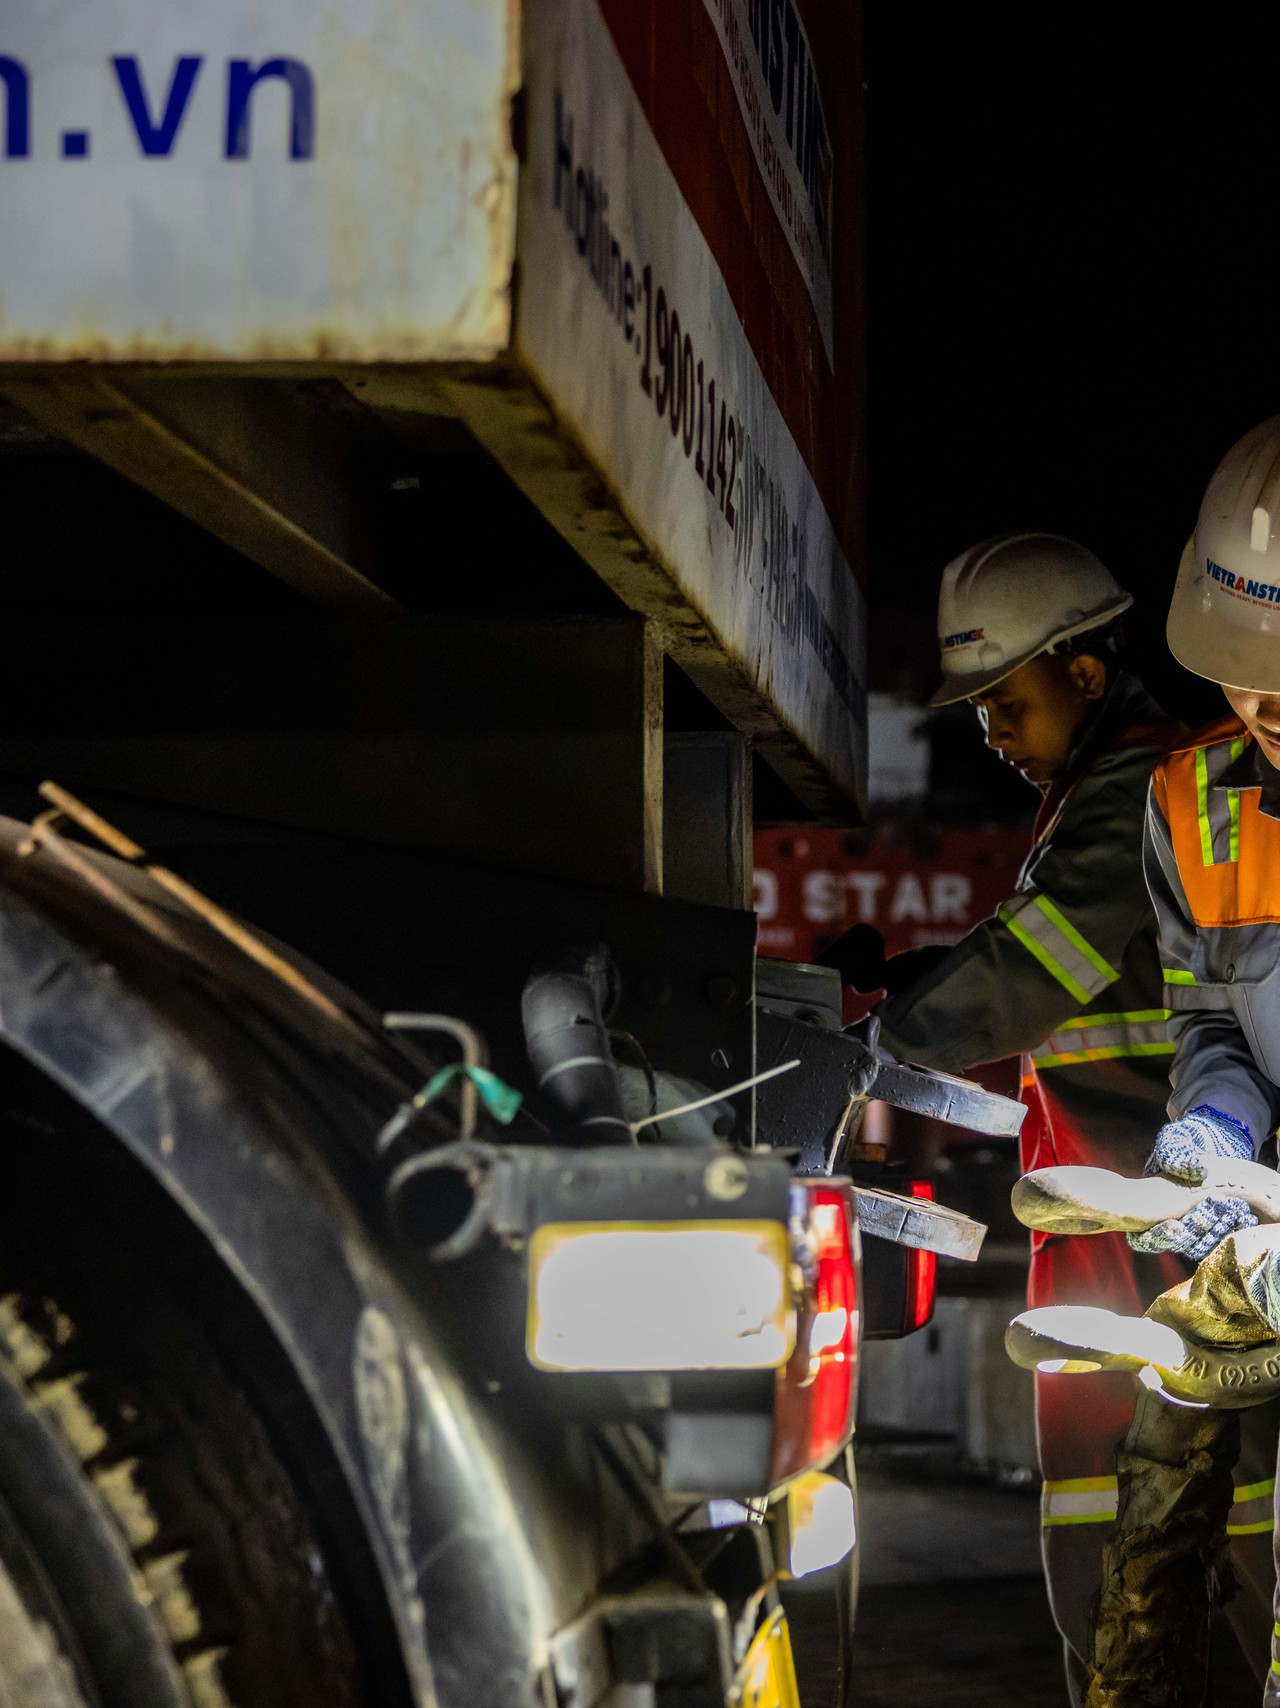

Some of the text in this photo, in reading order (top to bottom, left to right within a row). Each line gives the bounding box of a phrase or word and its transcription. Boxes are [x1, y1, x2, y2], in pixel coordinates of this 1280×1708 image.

[763, 118, 792, 227] BEYOND
[1220, 586, 1236, 598] BEYOND
[1252, 598, 1273, 609] BEYOND
[803, 869, 972, 922] STAR
